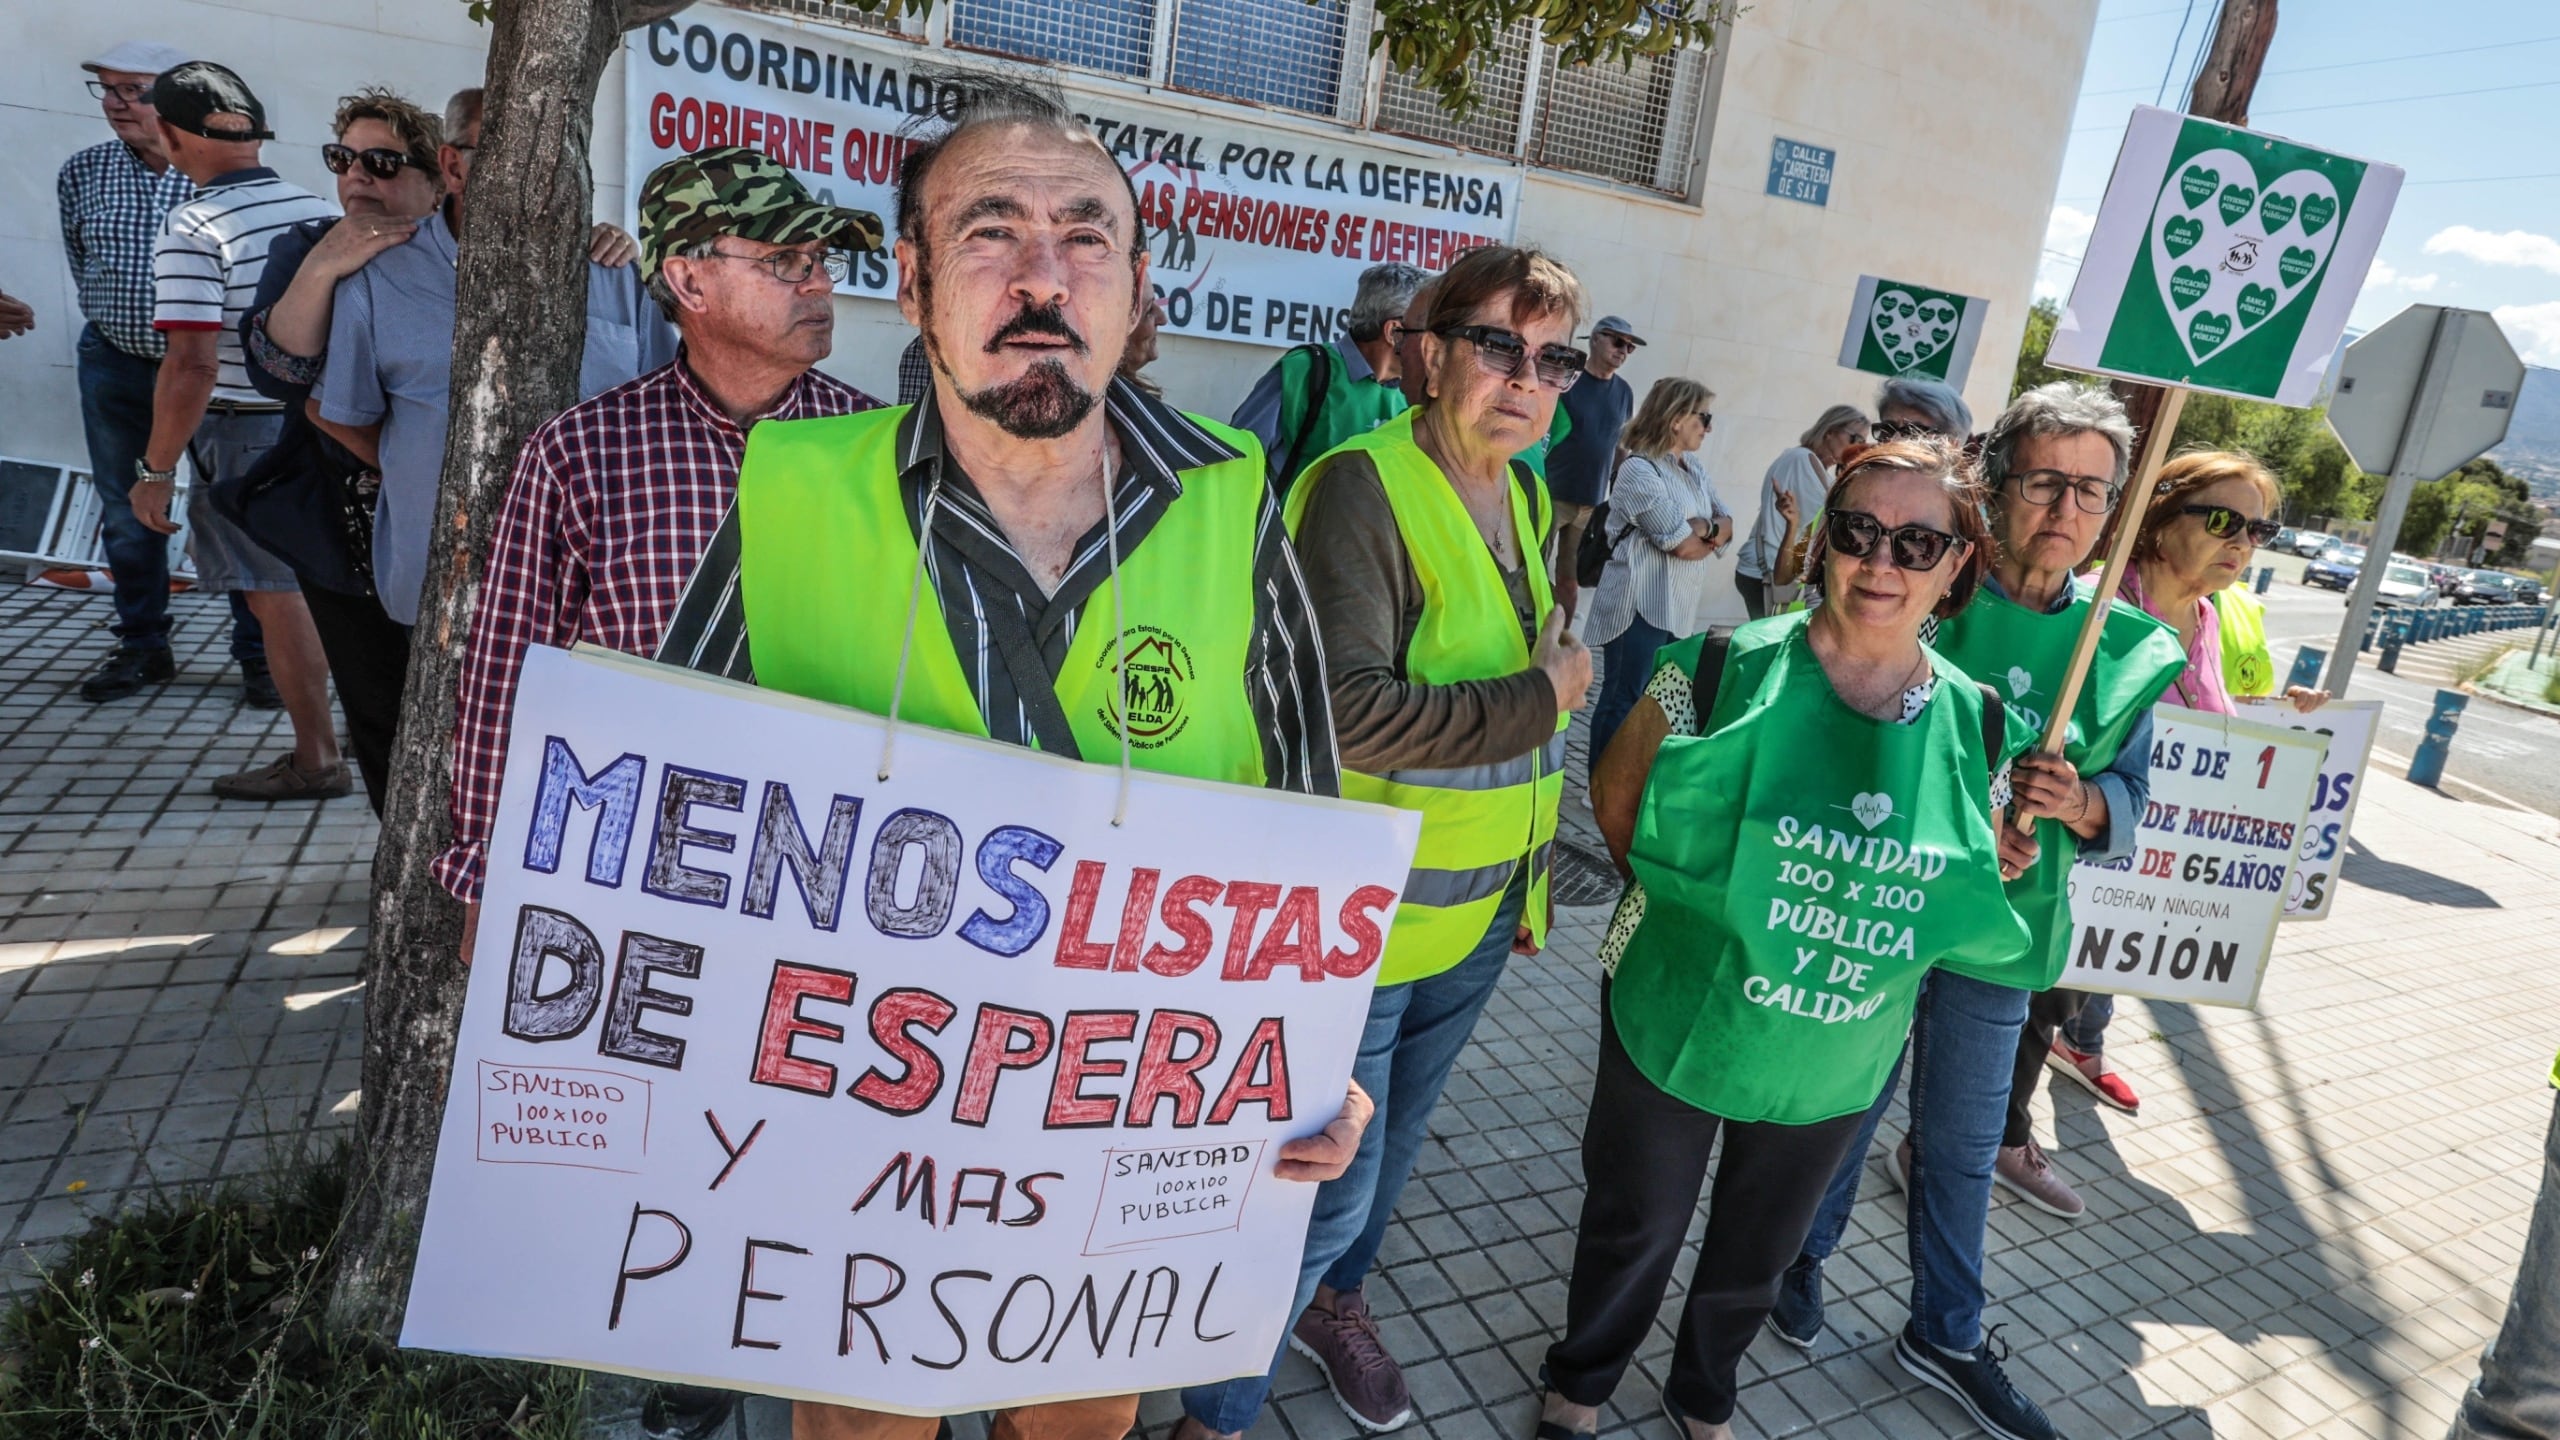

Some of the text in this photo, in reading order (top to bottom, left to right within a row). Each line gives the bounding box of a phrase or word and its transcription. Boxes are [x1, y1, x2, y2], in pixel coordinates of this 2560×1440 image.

[1783, 159, 1831, 185] CARRETERA
[1792, 145, 1826, 165] CALLE
[650, 92, 835, 175] GOBIERNE
[1139, 180, 1176, 231] AS
[1179, 186, 1327, 254] PENSIONES
[1331, 215, 1365, 260] SE
[1219, 142, 1295, 185] POR
[1304, 154, 1348, 194] LA
[1360, 161, 1503, 219] DEFENSA
[1778, 177, 1818, 201] DE SAX
[1206, 291, 1253, 336] DE
[1264, 298, 1351, 343] PENS
[2194, 323, 2225, 335] SANIDAD
[1138, 625, 1162, 635] Estatal
[1128, 663, 1171, 674] COESPE
[1128, 712, 1163, 724] ELDA
[2150, 728, 2186, 771] ÁS
[2191, 747, 2230, 780] DE
[2257, 745, 2277, 789] 1
[2141, 801, 2296, 851] DE MUJERES
[523, 735, 1398, 981] MENOS LISTAS
[1773, 816, 1947, 882] SANIDAD
[2139, 848, 2177, 879] DE
[1776, 860, 1834, 893] 100
[1872, 884, 1925, 913] 100
[2092, 886, 2156, 913] COBRAN
[2163, 895, 2230, 919] NINGUNA
[1767, 896, 1915, 960] PÚBLICA
[1792, 947, 1873, 993] Y DE
[501, 904, 1293, 1132] DE ESPERA
[487, 1070, 624, 1102] SANIDAD
[491, 1122, 608, 1150] PUBLICA
[704, 1109, 1065, 1230] Y MAS
[1114, 1145, 1250, 1177] SANIDAD
[1120, 1194, 1232, 1225] PUBLICA
[609, 1200, 1236, 1370] PERSONAL
